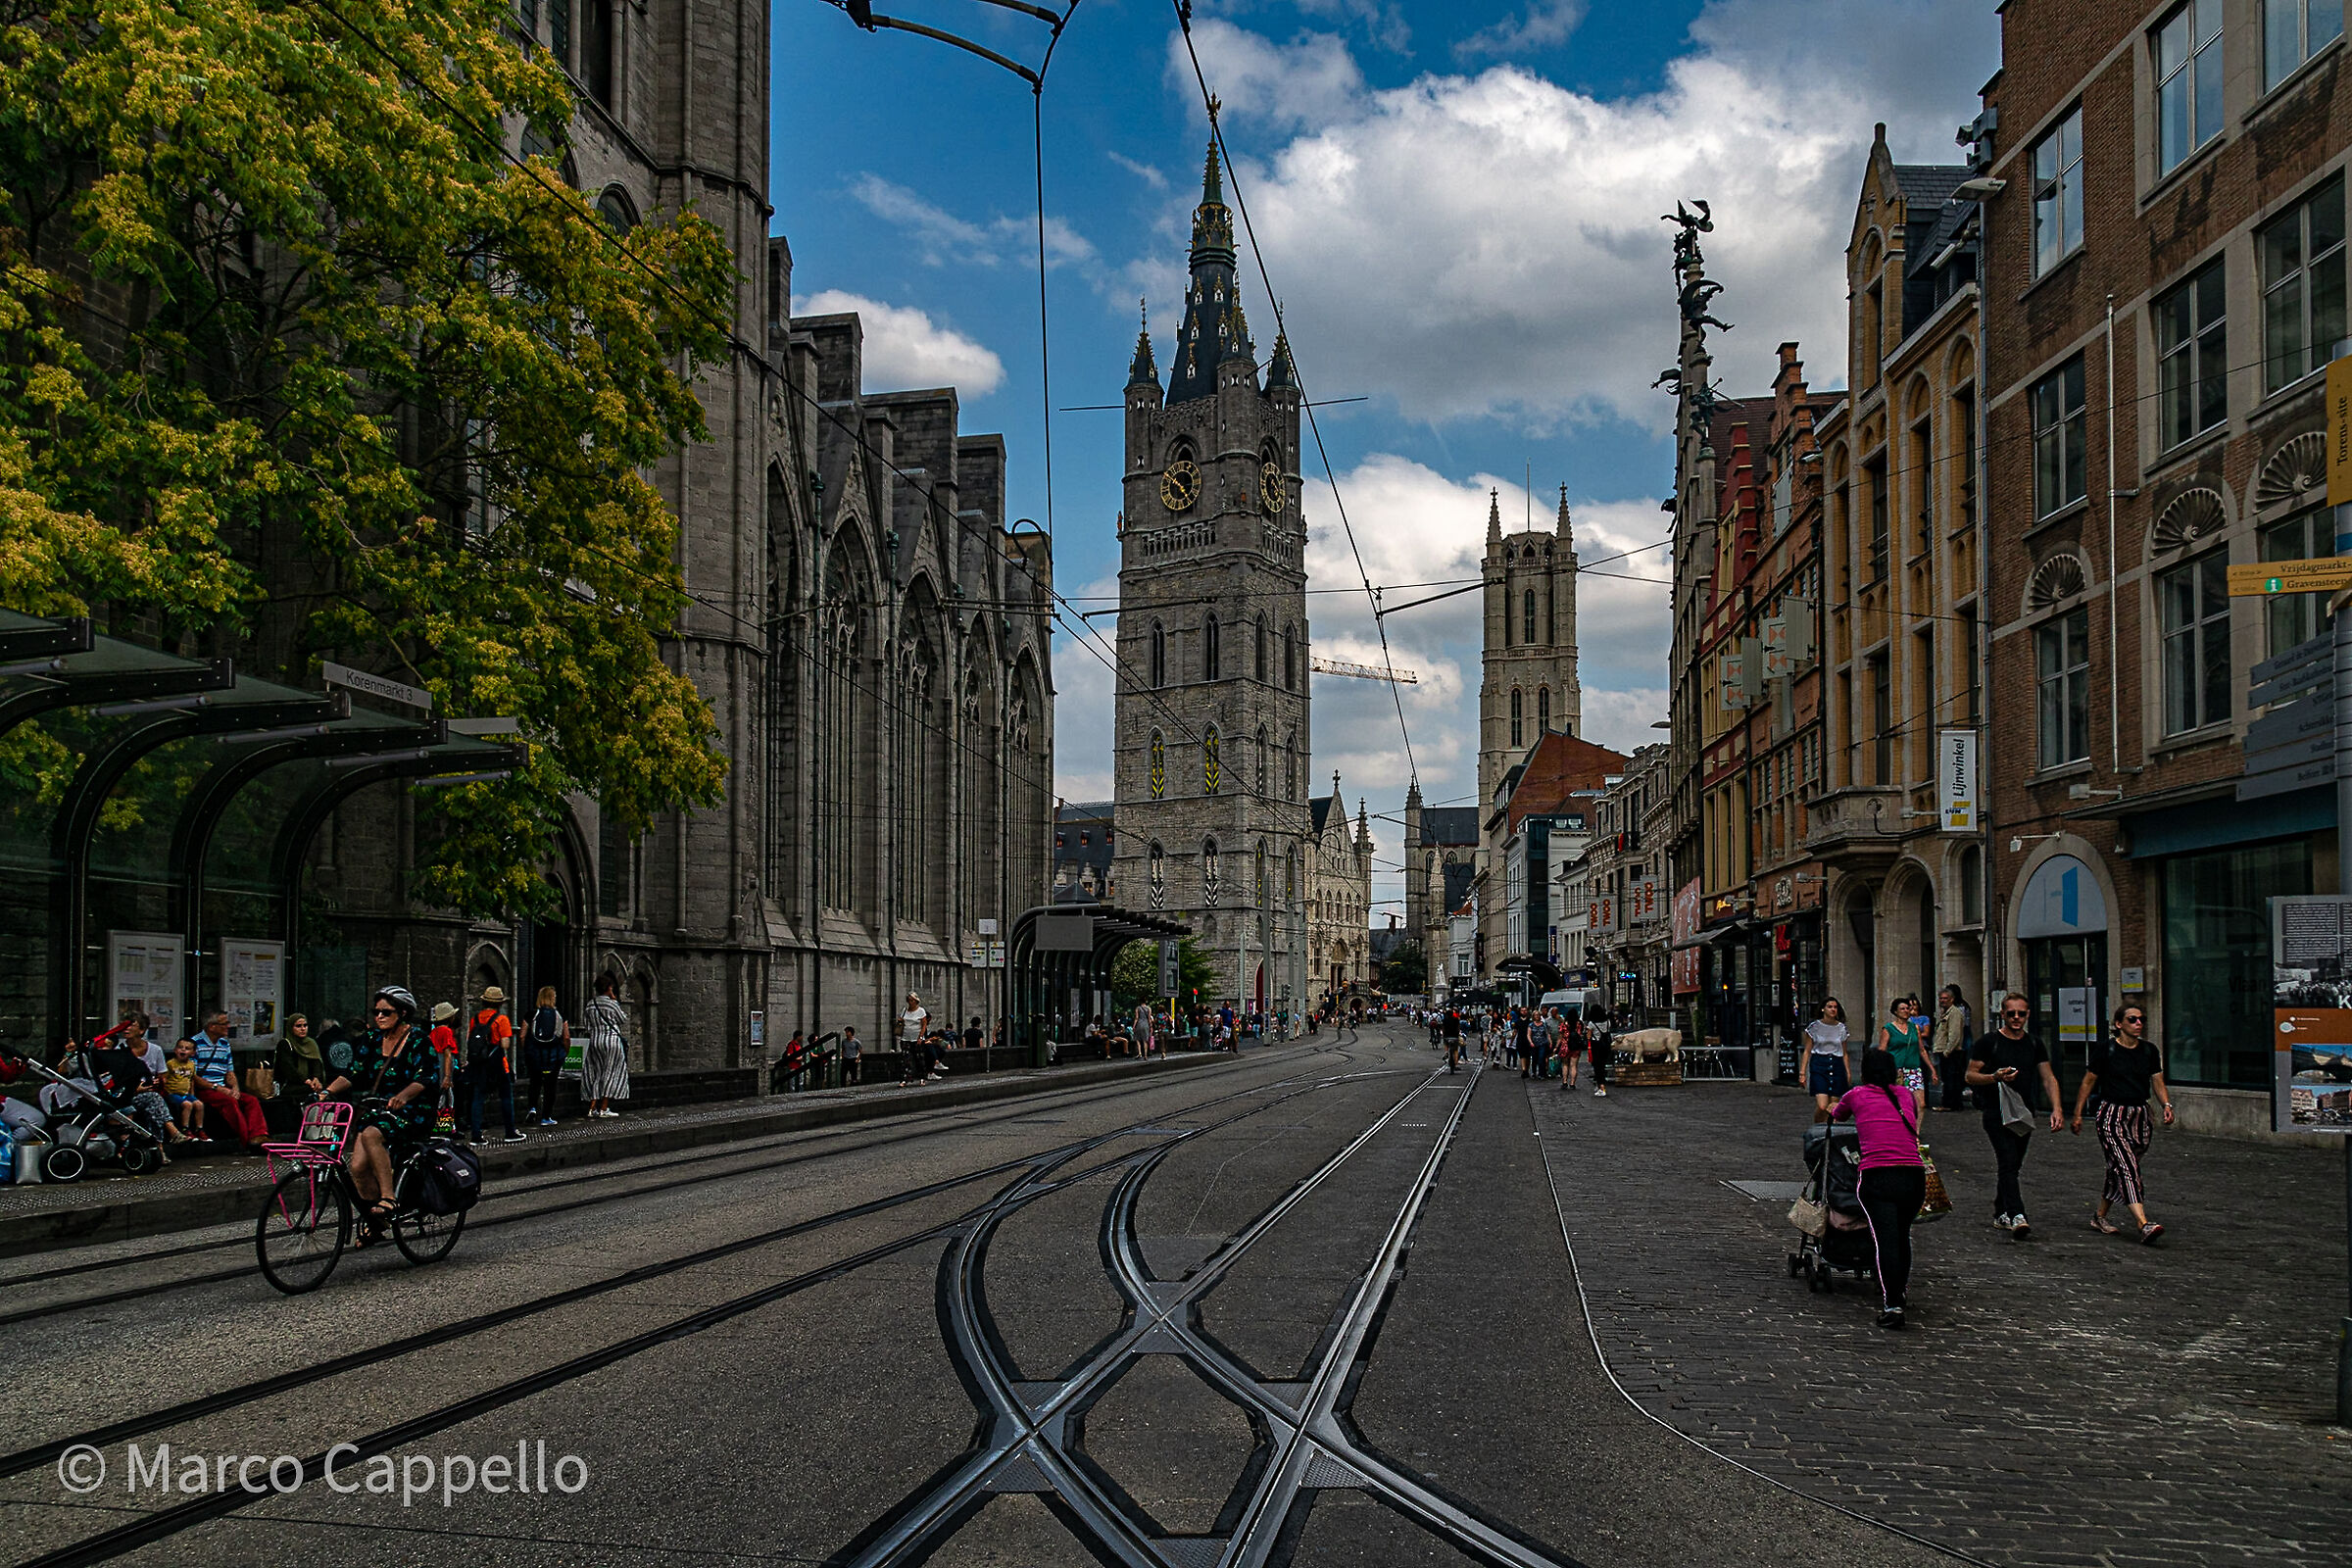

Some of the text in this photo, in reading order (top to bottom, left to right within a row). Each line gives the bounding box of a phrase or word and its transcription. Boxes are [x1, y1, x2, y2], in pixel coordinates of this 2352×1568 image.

[2336, 396, 2348, 466] Torens-site
[346, 669, 414, 702] Korenmarkt 3
[1953, 739, 1967, 797] Lijnwinkel
[1645, 882, 1654, 913] TWOO
